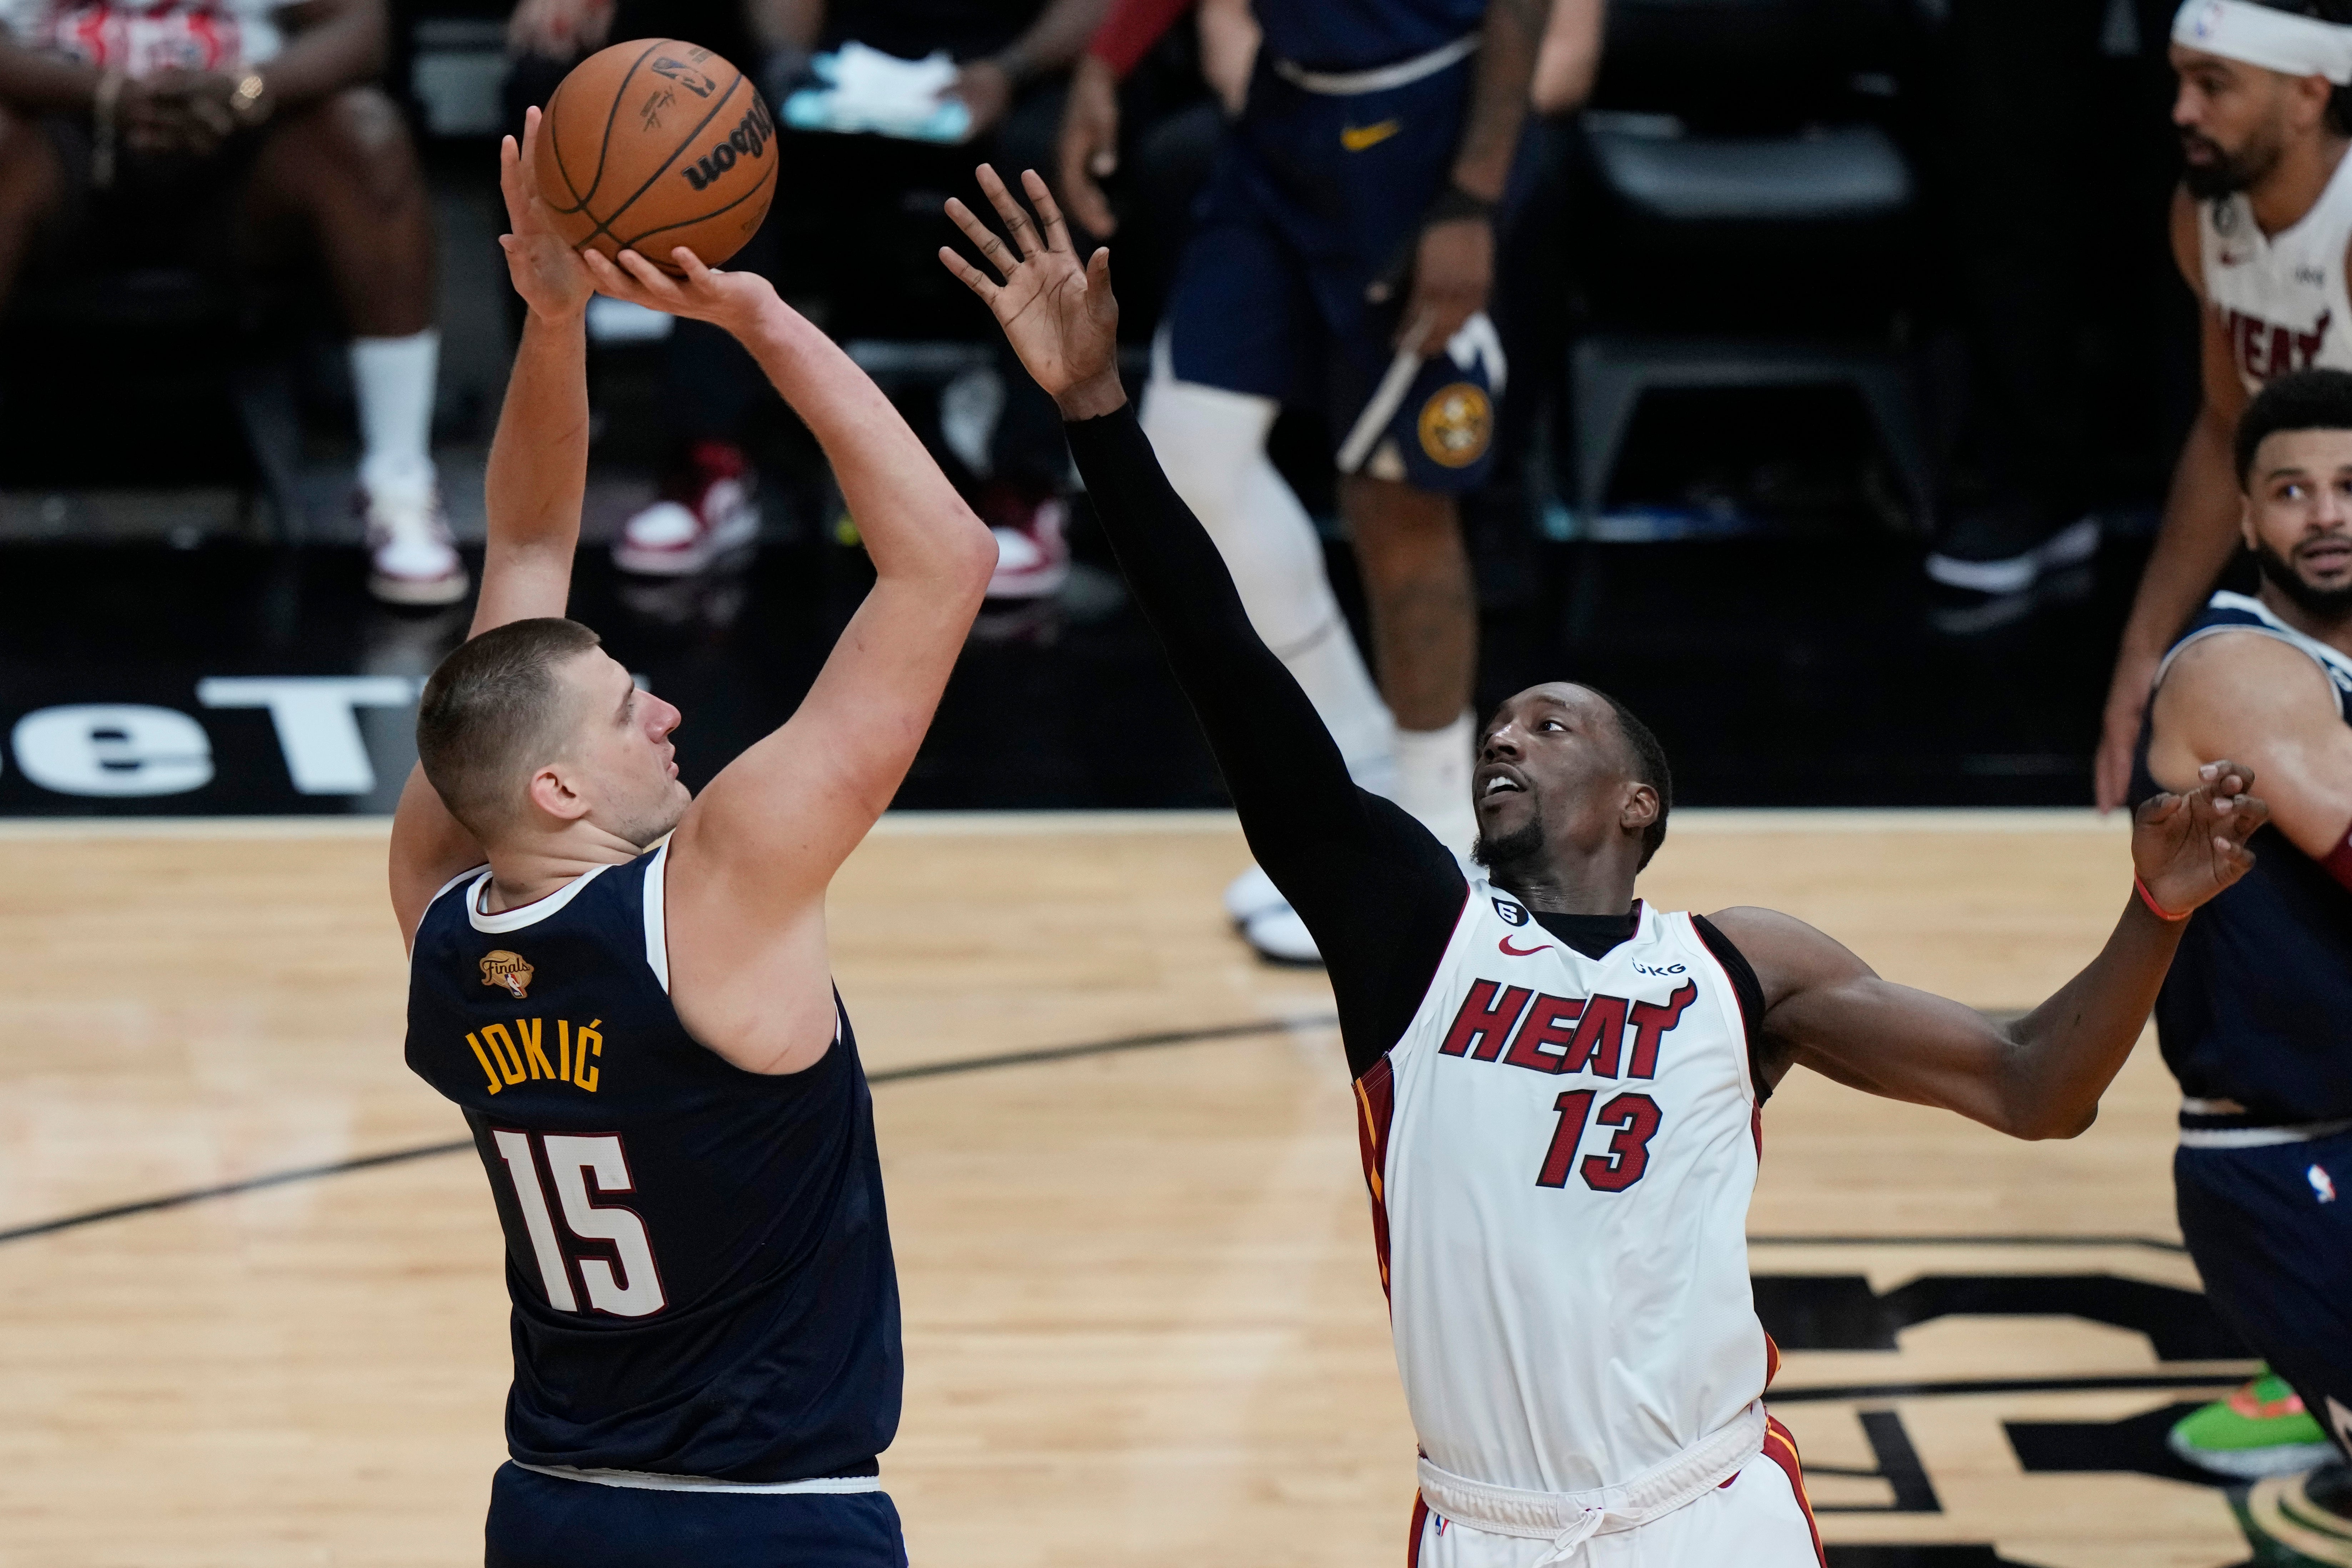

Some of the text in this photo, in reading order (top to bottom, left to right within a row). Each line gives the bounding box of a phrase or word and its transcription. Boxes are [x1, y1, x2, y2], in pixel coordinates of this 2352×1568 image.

[1498, 902, 1518, 924] 6
[482, 958, 530, 983] Finals
[1632, 957, 1686, 976] UKG
[465, 1018, 603, 1095] JOKIĆ
[1438, 977, 1698, 1079] HEAT
[1535, 1089, 1663, 1193] 13
[491, 1128, 670, 1318] 15
